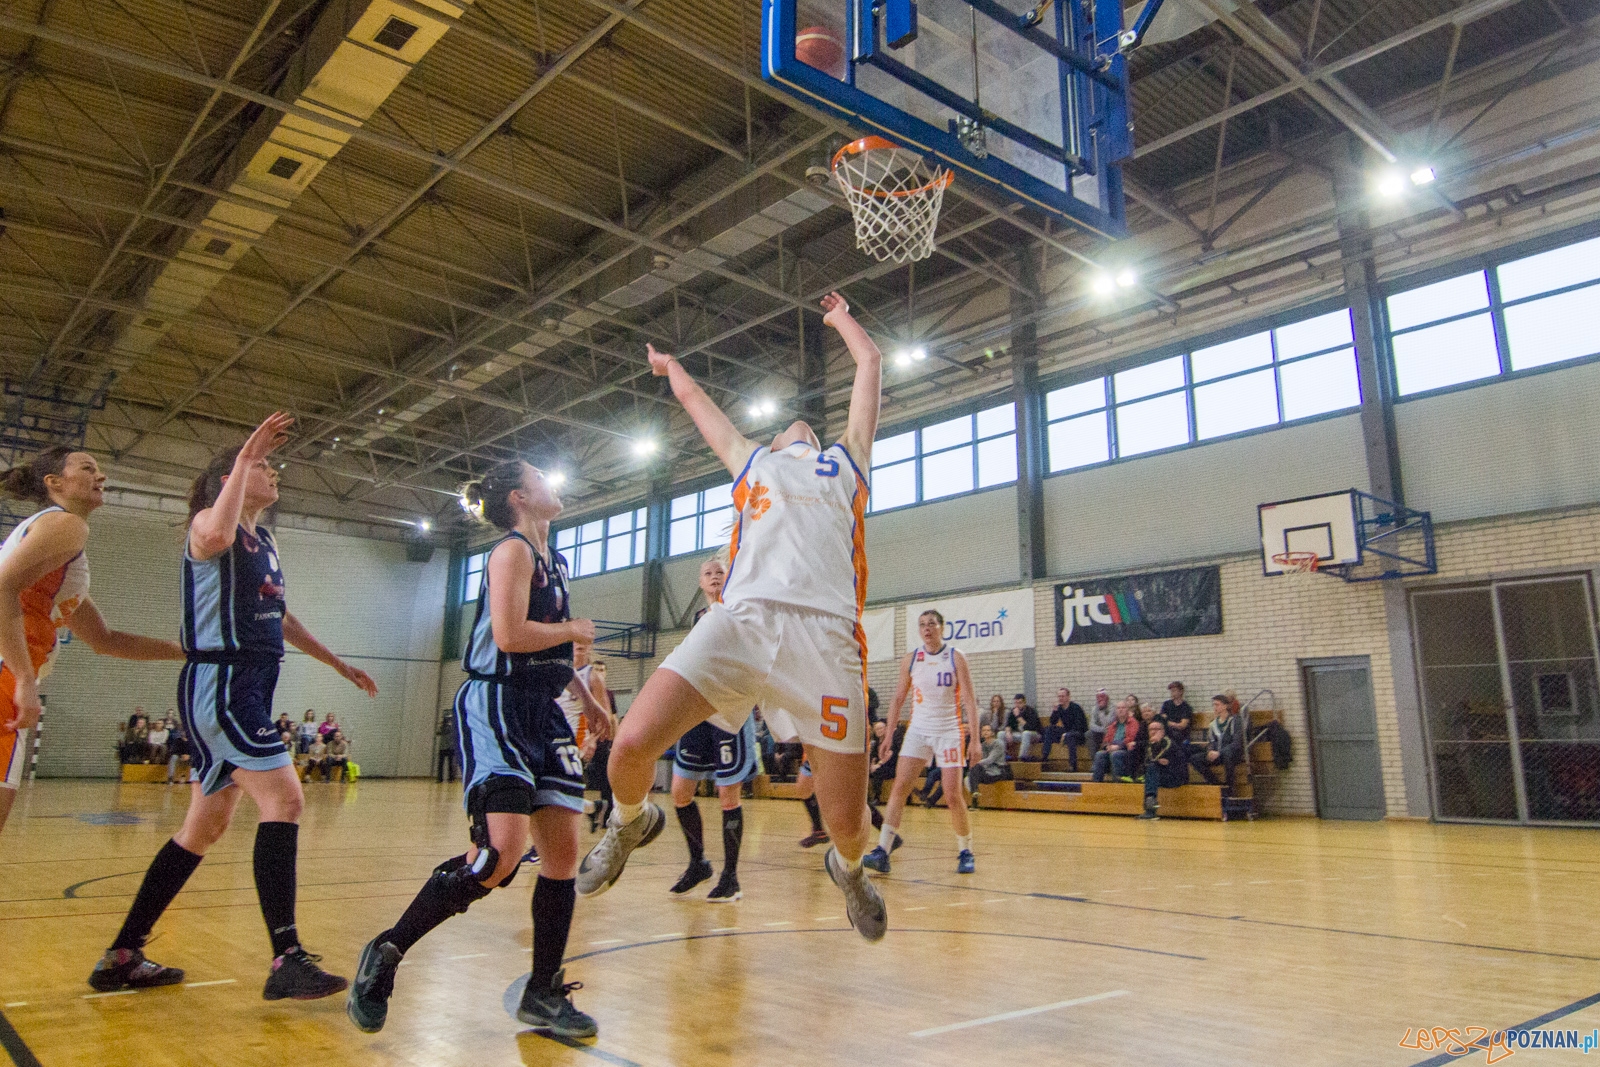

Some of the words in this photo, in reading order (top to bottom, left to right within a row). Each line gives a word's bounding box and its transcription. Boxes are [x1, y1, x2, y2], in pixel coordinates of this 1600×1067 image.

[815, 453, 840, 477] 5
[1061, 586, 1114, 643] jtc
[937, 671, 952, 687] 10
[820, 695, 849, 741] 5
[556, 744, 583, 776] 13
[720, 744, 733, 765] 6
[943, 748, 958, 763] 10
